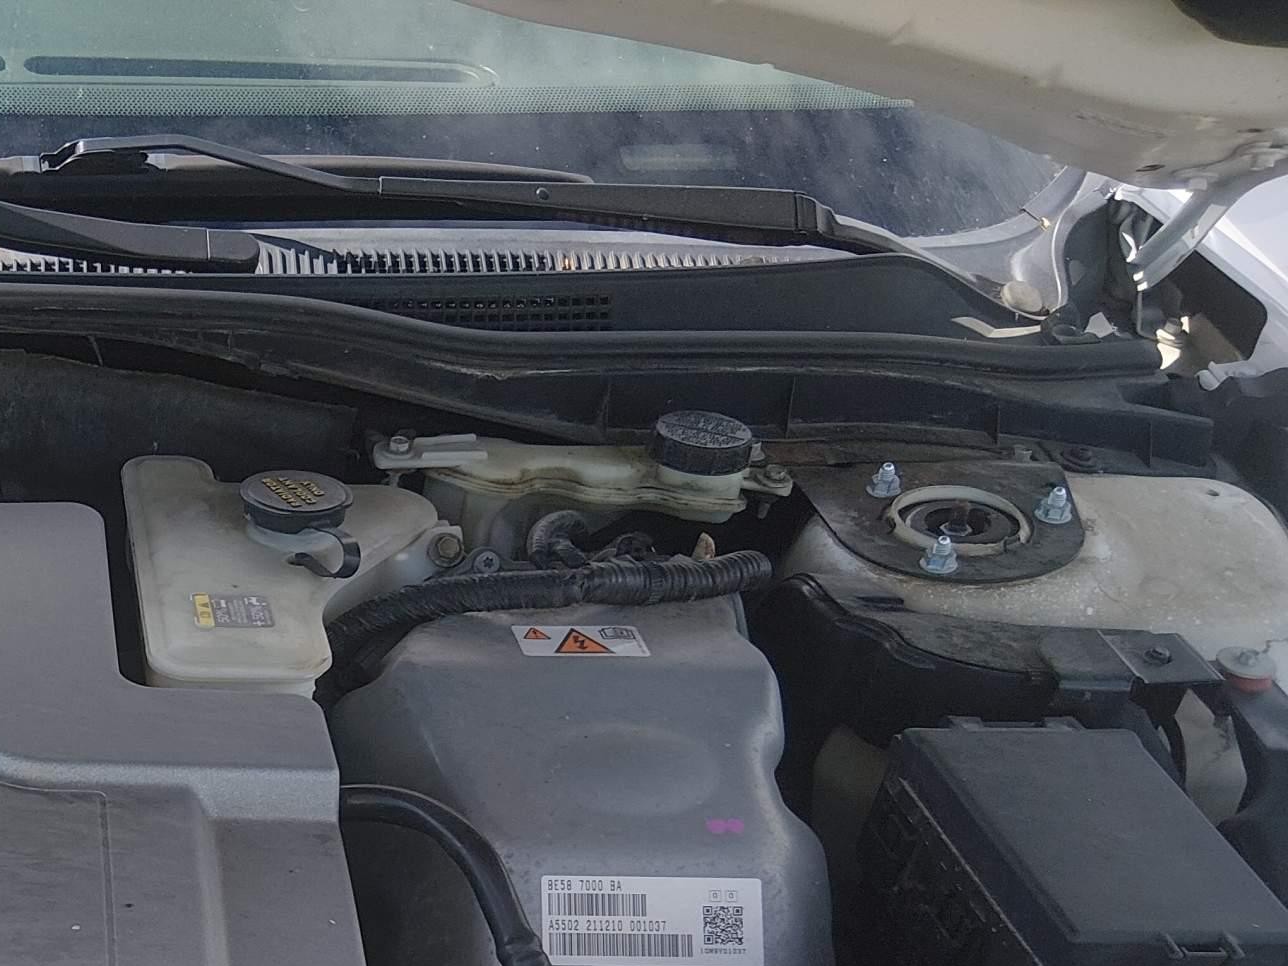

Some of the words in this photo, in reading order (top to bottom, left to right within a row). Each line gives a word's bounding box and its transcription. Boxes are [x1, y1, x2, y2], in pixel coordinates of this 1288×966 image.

[580, 880, 604, 891] 7000
[548, 920, 580, 931] A5502
[586, 920, 623, 931] 211210
[629, 921, 667, 932] 001037
